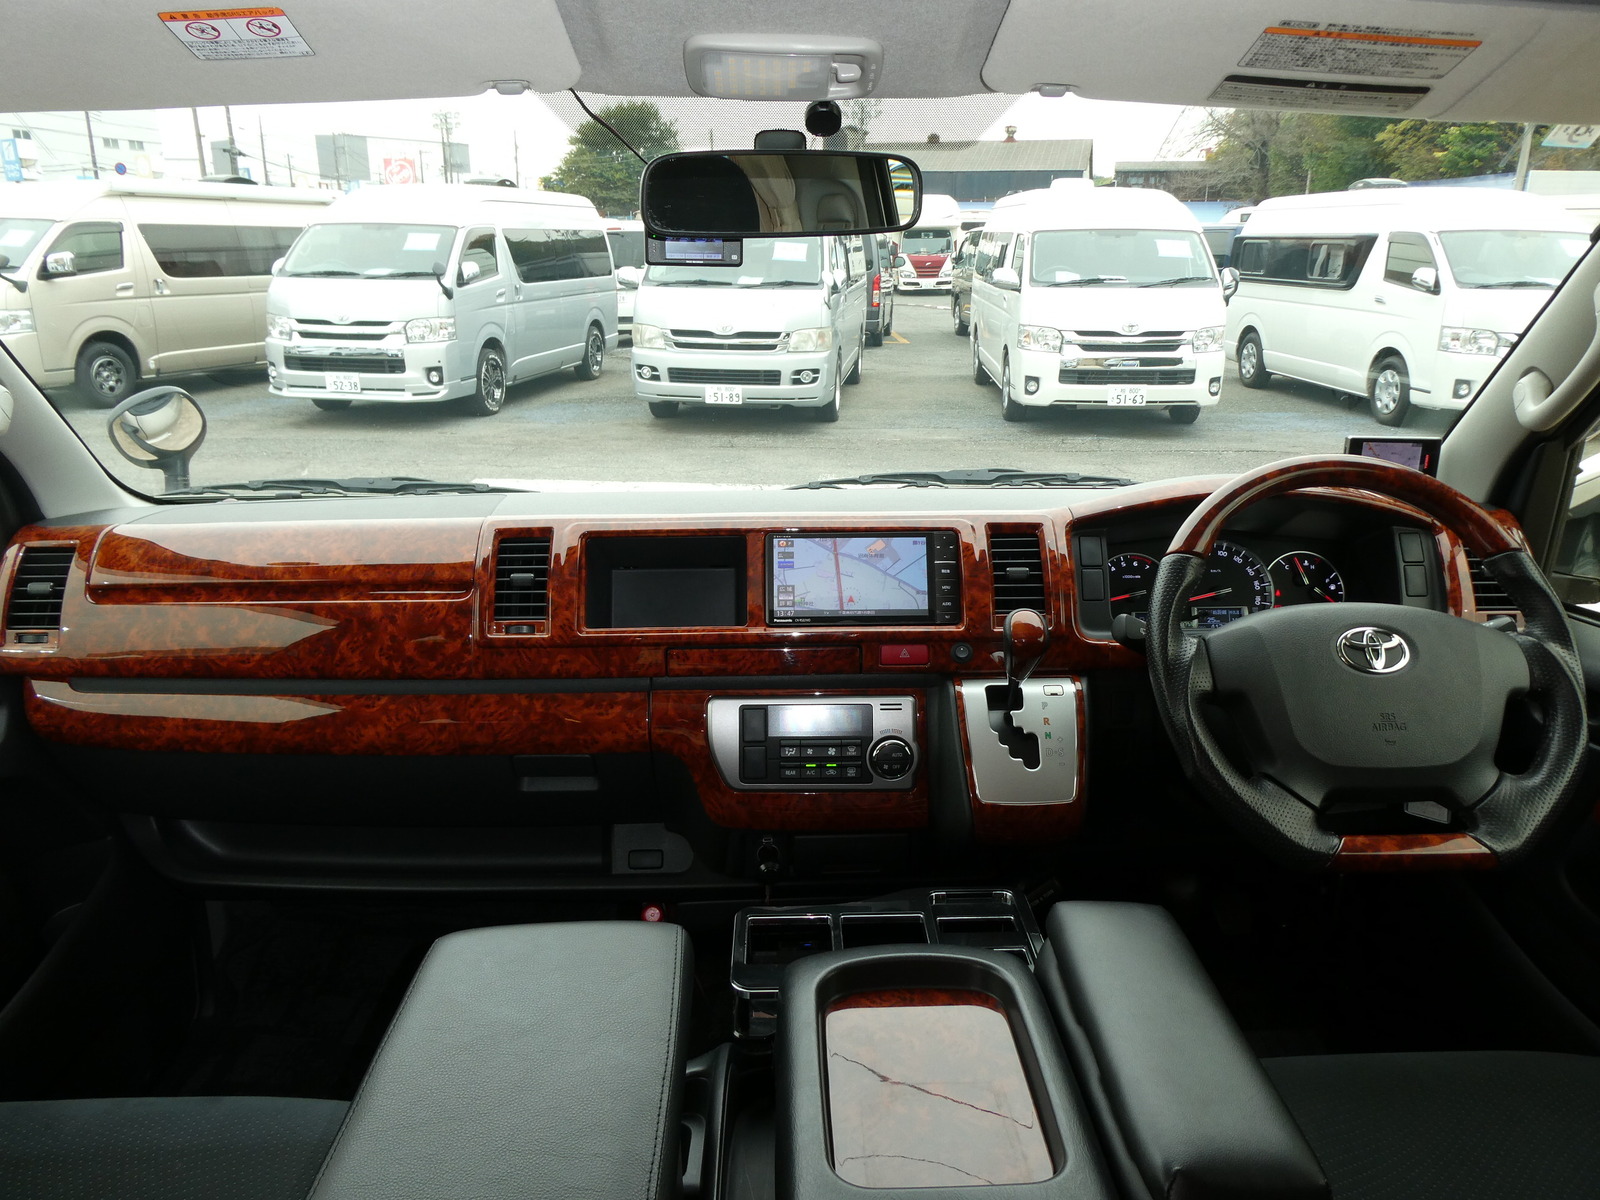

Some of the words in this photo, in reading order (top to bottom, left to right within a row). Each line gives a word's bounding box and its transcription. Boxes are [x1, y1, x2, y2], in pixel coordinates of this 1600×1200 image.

[333, 380, 359, 391] 52-38
[713, 392, 740, 403] 51-89
[1116, 394, 1145, 405] 51-63
[1233, 555, 1243, 564] 120
[1245, 565, 1255, 576] 140
[1253, 580, 1261, 590] 160
[1041, 701, 1049, 710] P
[1043, 717, 1051, 726] R
[1380, 712, 1396, 721] SRS
[1372, 721, 1407, 731] AIRBAG
[1044, 731, 1052, 740] N
